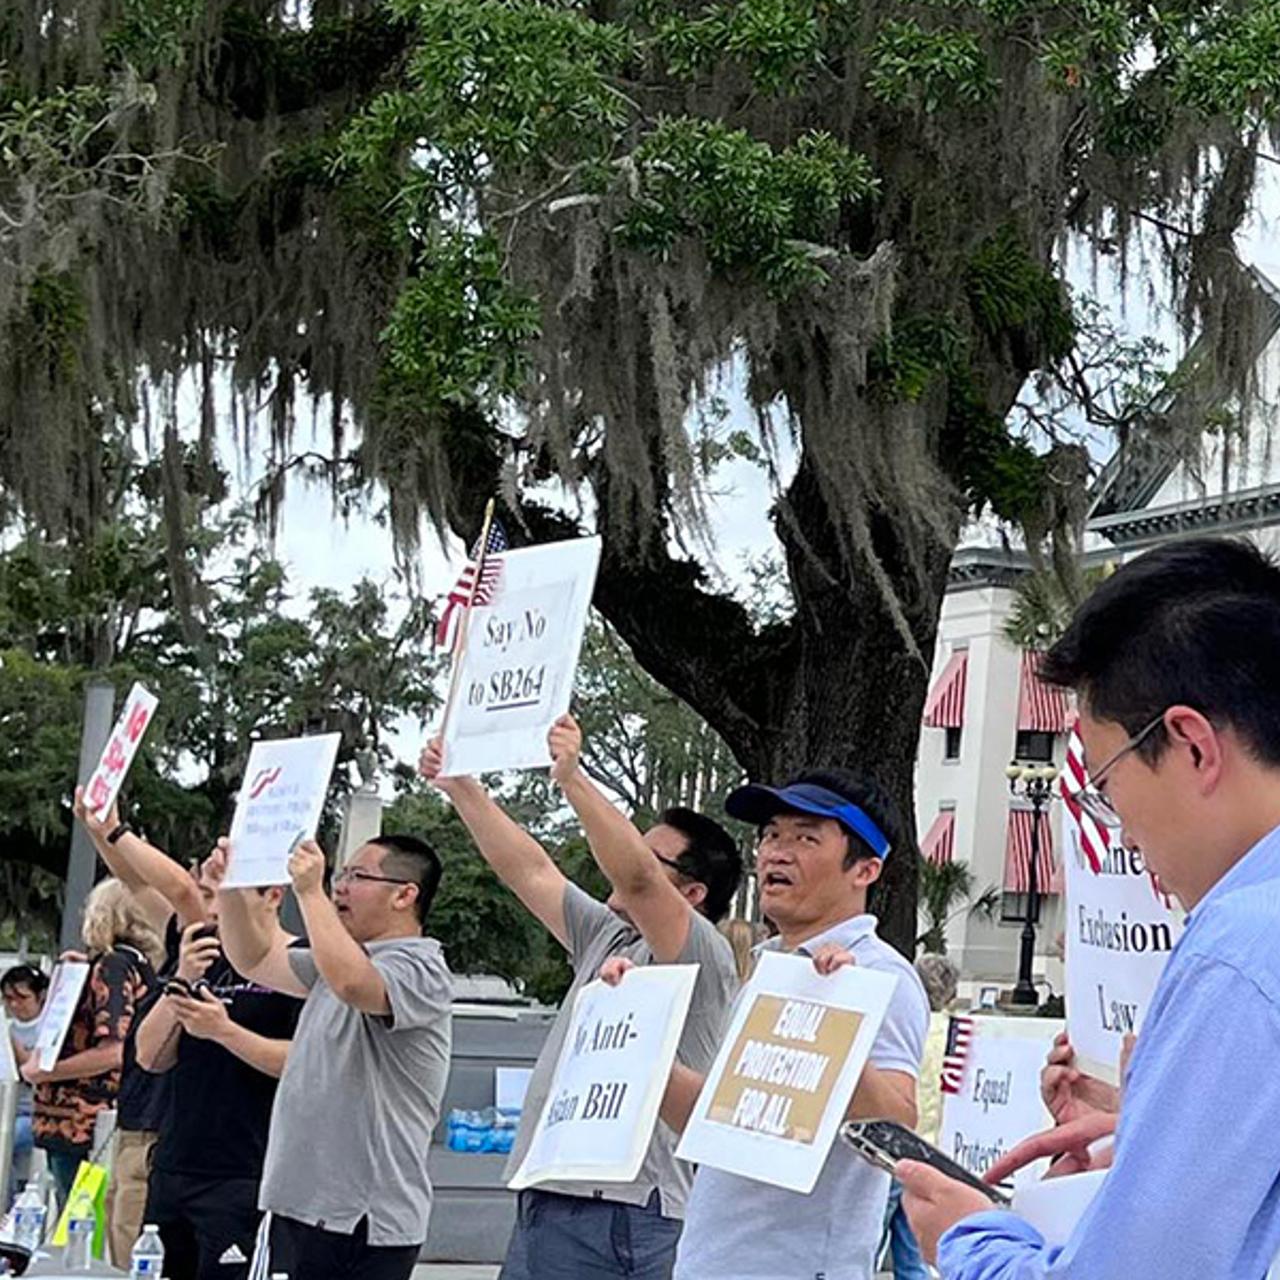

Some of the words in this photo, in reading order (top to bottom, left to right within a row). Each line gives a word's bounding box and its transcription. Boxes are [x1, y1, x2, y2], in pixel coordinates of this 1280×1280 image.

[484, 615, 513, 651] Say
[520, 611, 546, 641] No
[469, 681, 484, 705] to
[488, 665, 545, 703] SB264
[1079, 905, 1172, 952] Exclusion
[773, 1000, 826, 1041] EQUAL
[1098, 985, 1137, 1032] Law
[589, 1013, 637, 1051] Anti-
[734, 1040, 829, 1092] PROTECTION
[582, 1083, 627, 1120] Bill
[732, 1088, 767, 1132] FOR
[761, 1094, 792, 1135] ALL
[973, 1069, 1012, 1113] Equal
[955, 1133, 1008, 1171] Protecti
